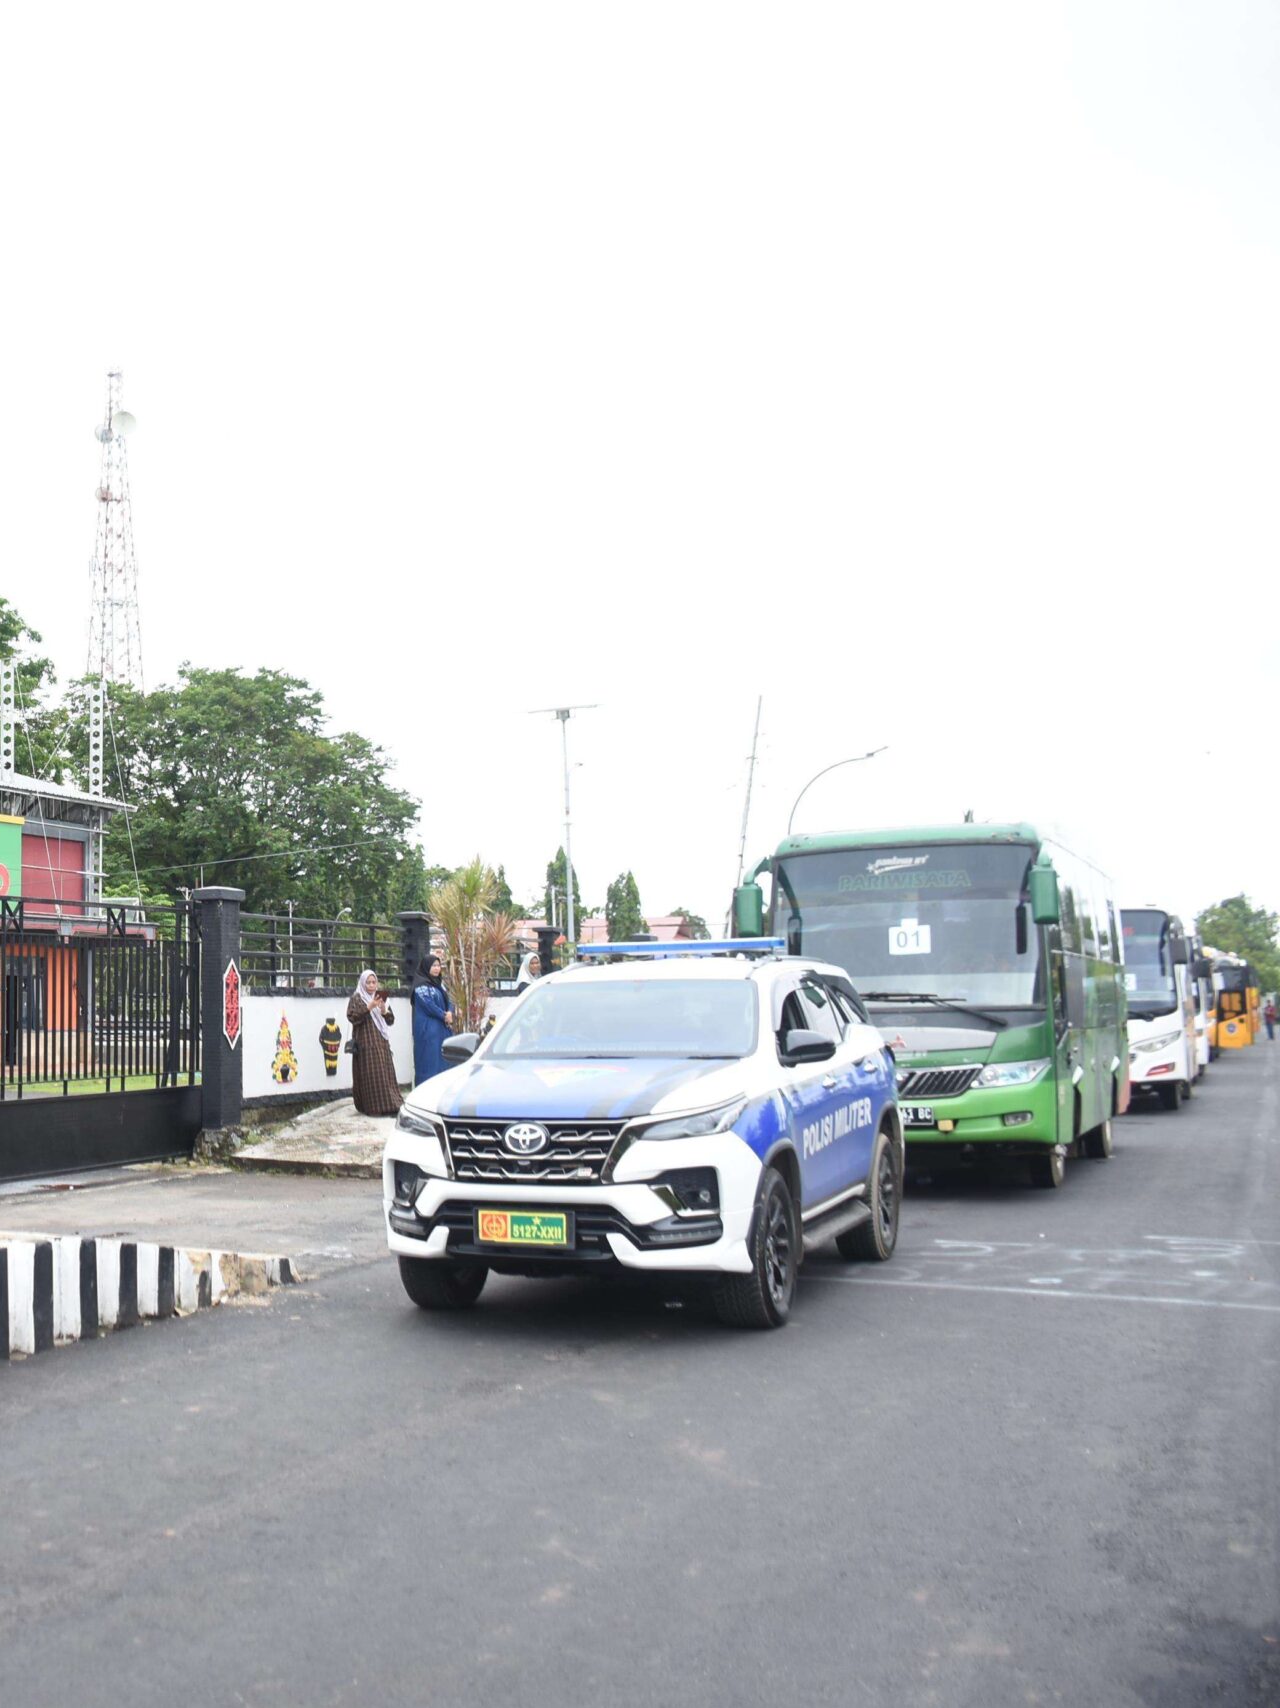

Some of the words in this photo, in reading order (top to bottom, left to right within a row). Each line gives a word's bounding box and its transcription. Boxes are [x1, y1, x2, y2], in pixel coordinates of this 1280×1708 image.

[838, 869, 972, 892] PARIWISATA
[896, 930, 920, 948] 01
[803, 1112, 833, 1160] POLISI
[834, 1096, 872, 1140] MILITER
